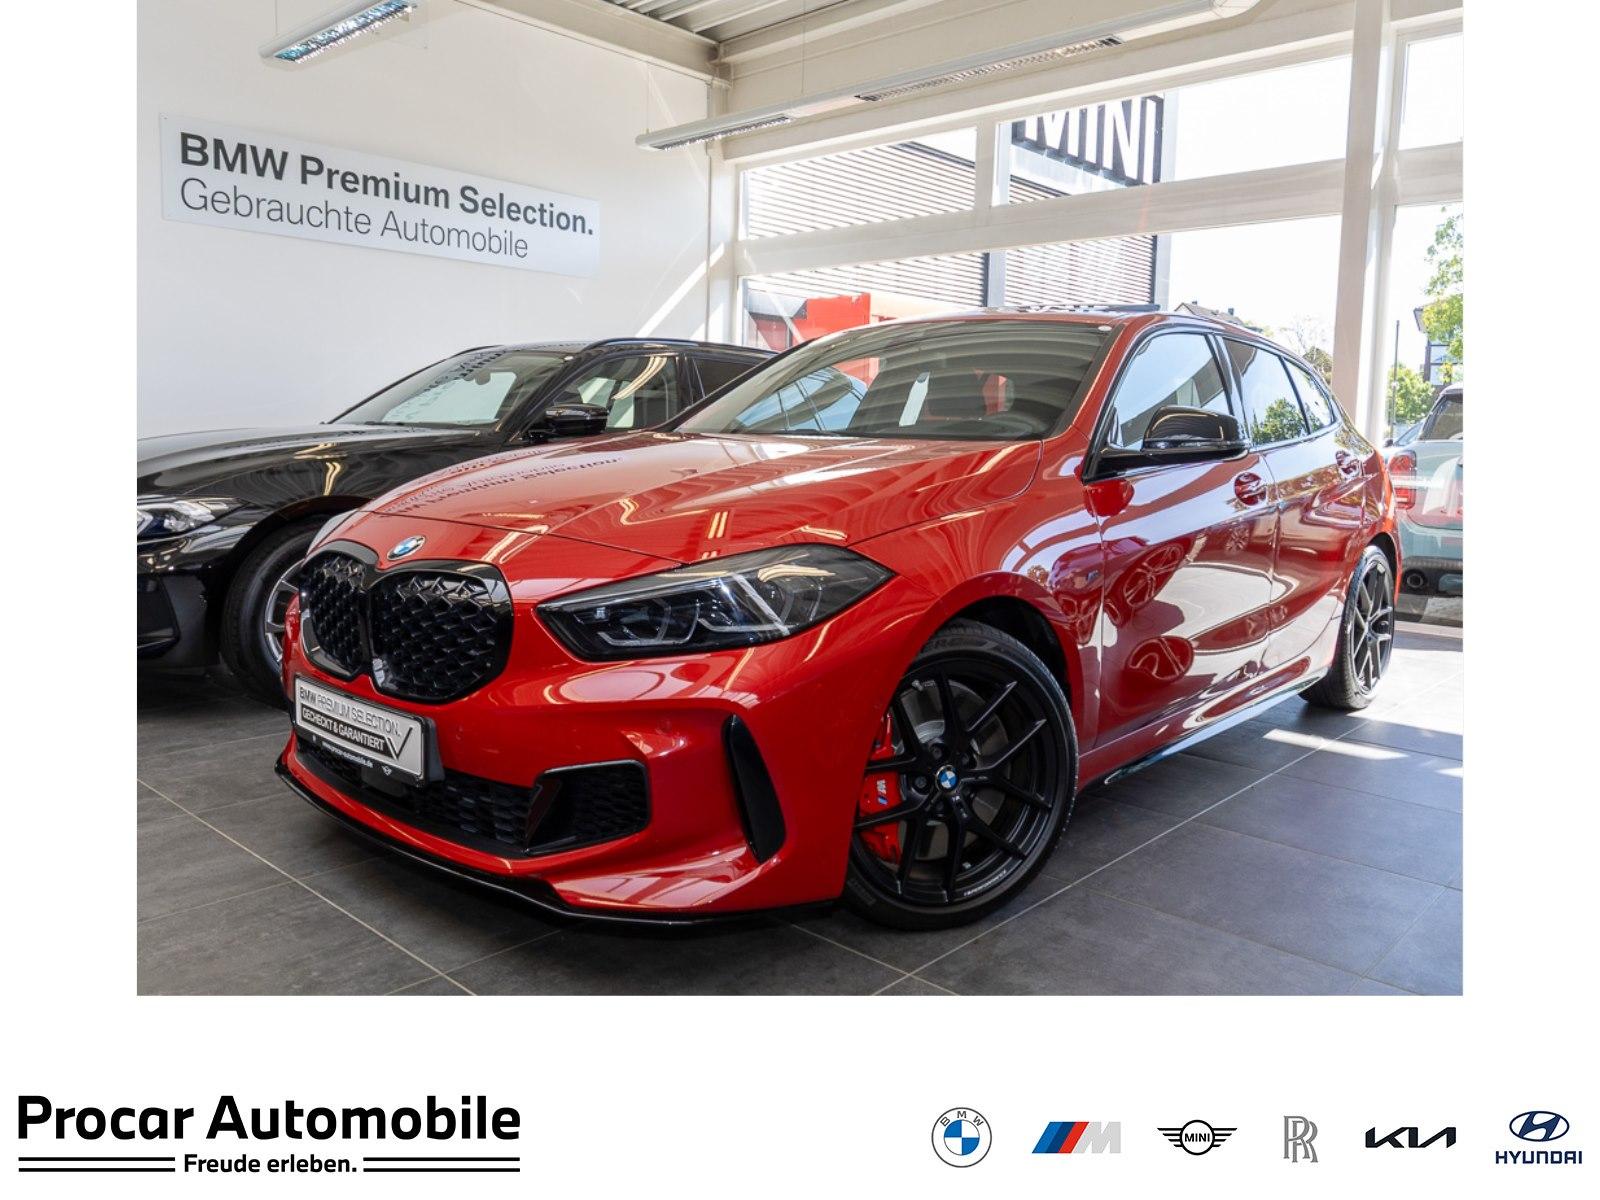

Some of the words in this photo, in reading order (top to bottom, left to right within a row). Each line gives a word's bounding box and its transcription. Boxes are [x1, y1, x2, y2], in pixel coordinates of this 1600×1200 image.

[180, 131, 289, 181] BMW
[300, 154, 450, 210] Premium
[459, 185, 594, 236] Selection.
[180, 177, 371, 235] Gebrauchte
[380, 210, 529, 259] Automobile
[299, 686, 317, 703] BMW
[317, 693, 350, 718] PREMIUM
[302, 707, 334, 732] GECHECKT
[338, 723, 386, 751] GARANTIERT
